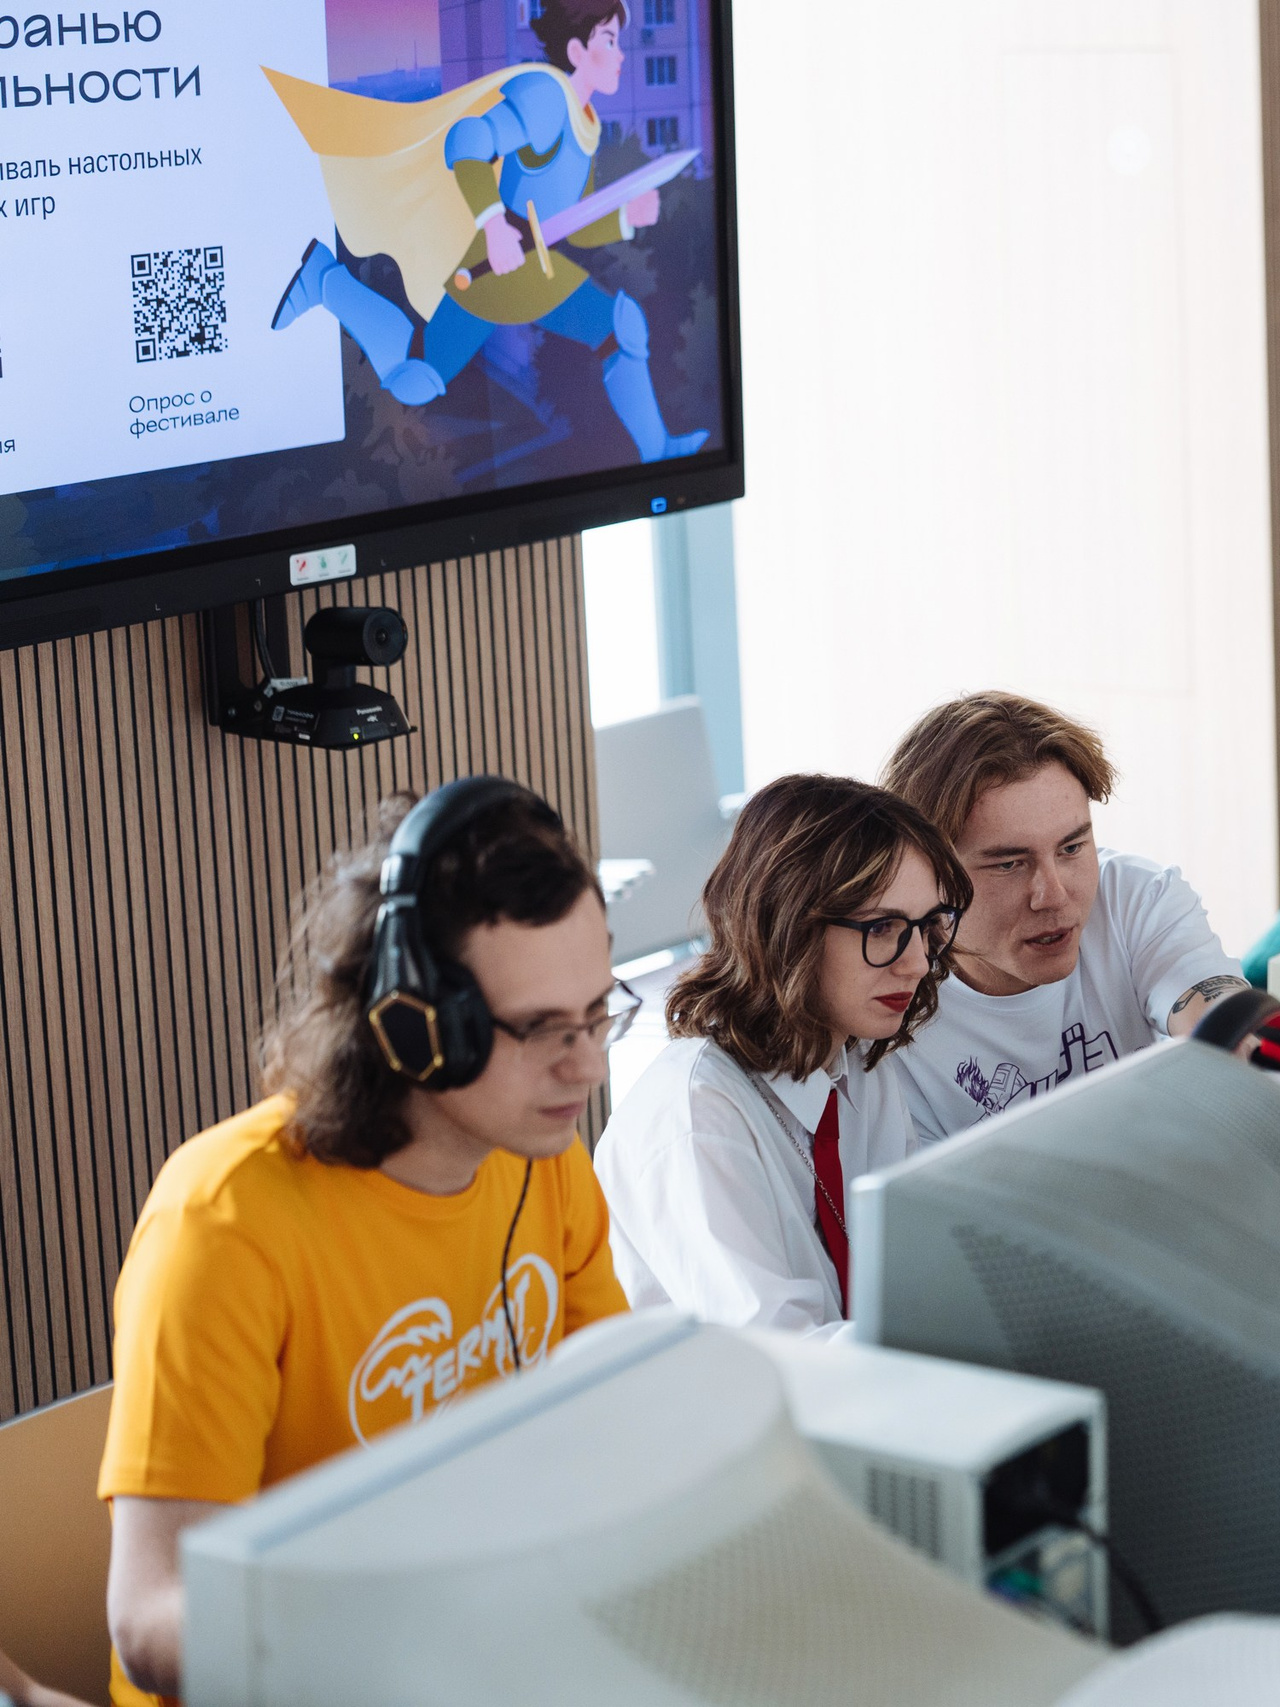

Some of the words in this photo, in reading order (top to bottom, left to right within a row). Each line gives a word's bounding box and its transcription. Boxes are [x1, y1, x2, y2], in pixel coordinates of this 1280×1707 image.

[0, 64, 201, 109] ьности
[68, 147, 203, 175] настольных
[15, 195, 56, 220] игр
[129, 393, 196, 414] Опрос
[200, 390, 212, 403] о
[129, 407, 240, 439] фестивале
[0, 439, 15, 453] я
